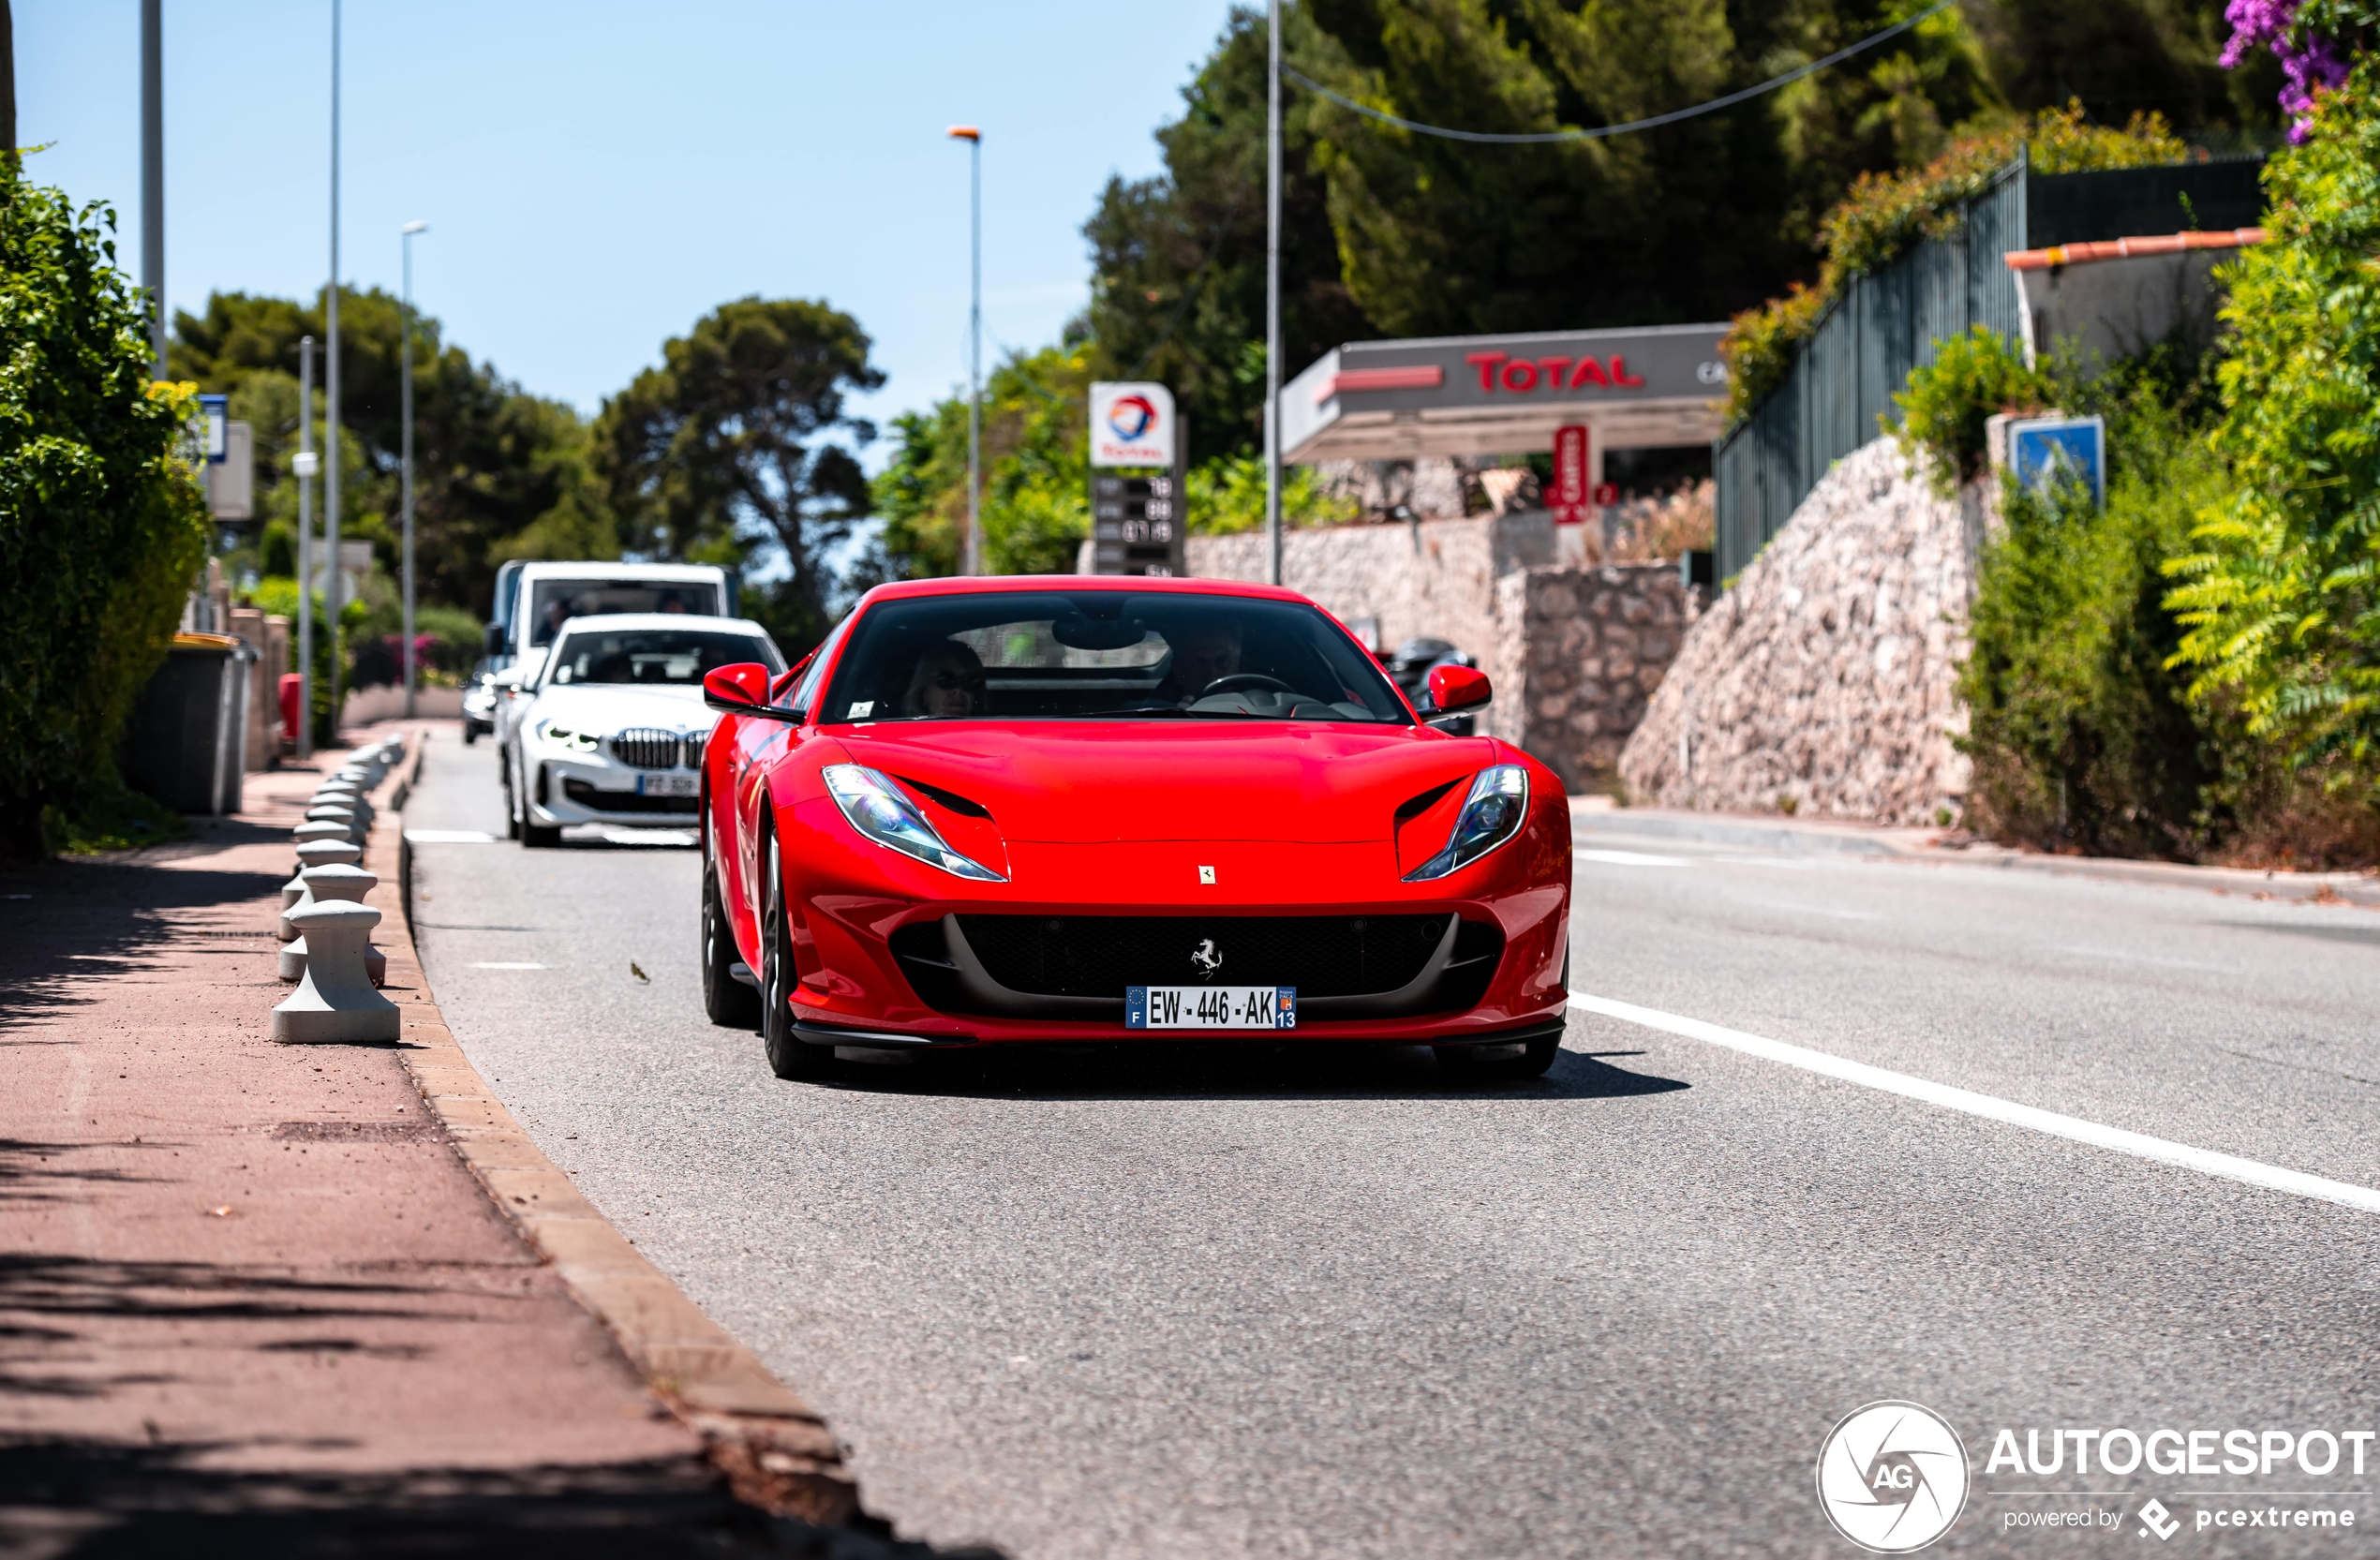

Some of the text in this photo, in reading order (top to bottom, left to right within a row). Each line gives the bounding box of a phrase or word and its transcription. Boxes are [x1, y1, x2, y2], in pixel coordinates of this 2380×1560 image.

[1466, 350, 1644, 394] TOTAL
[1132, 1012, 1140, 1023] F
[1277, 1012, 1296, 1028] 13
